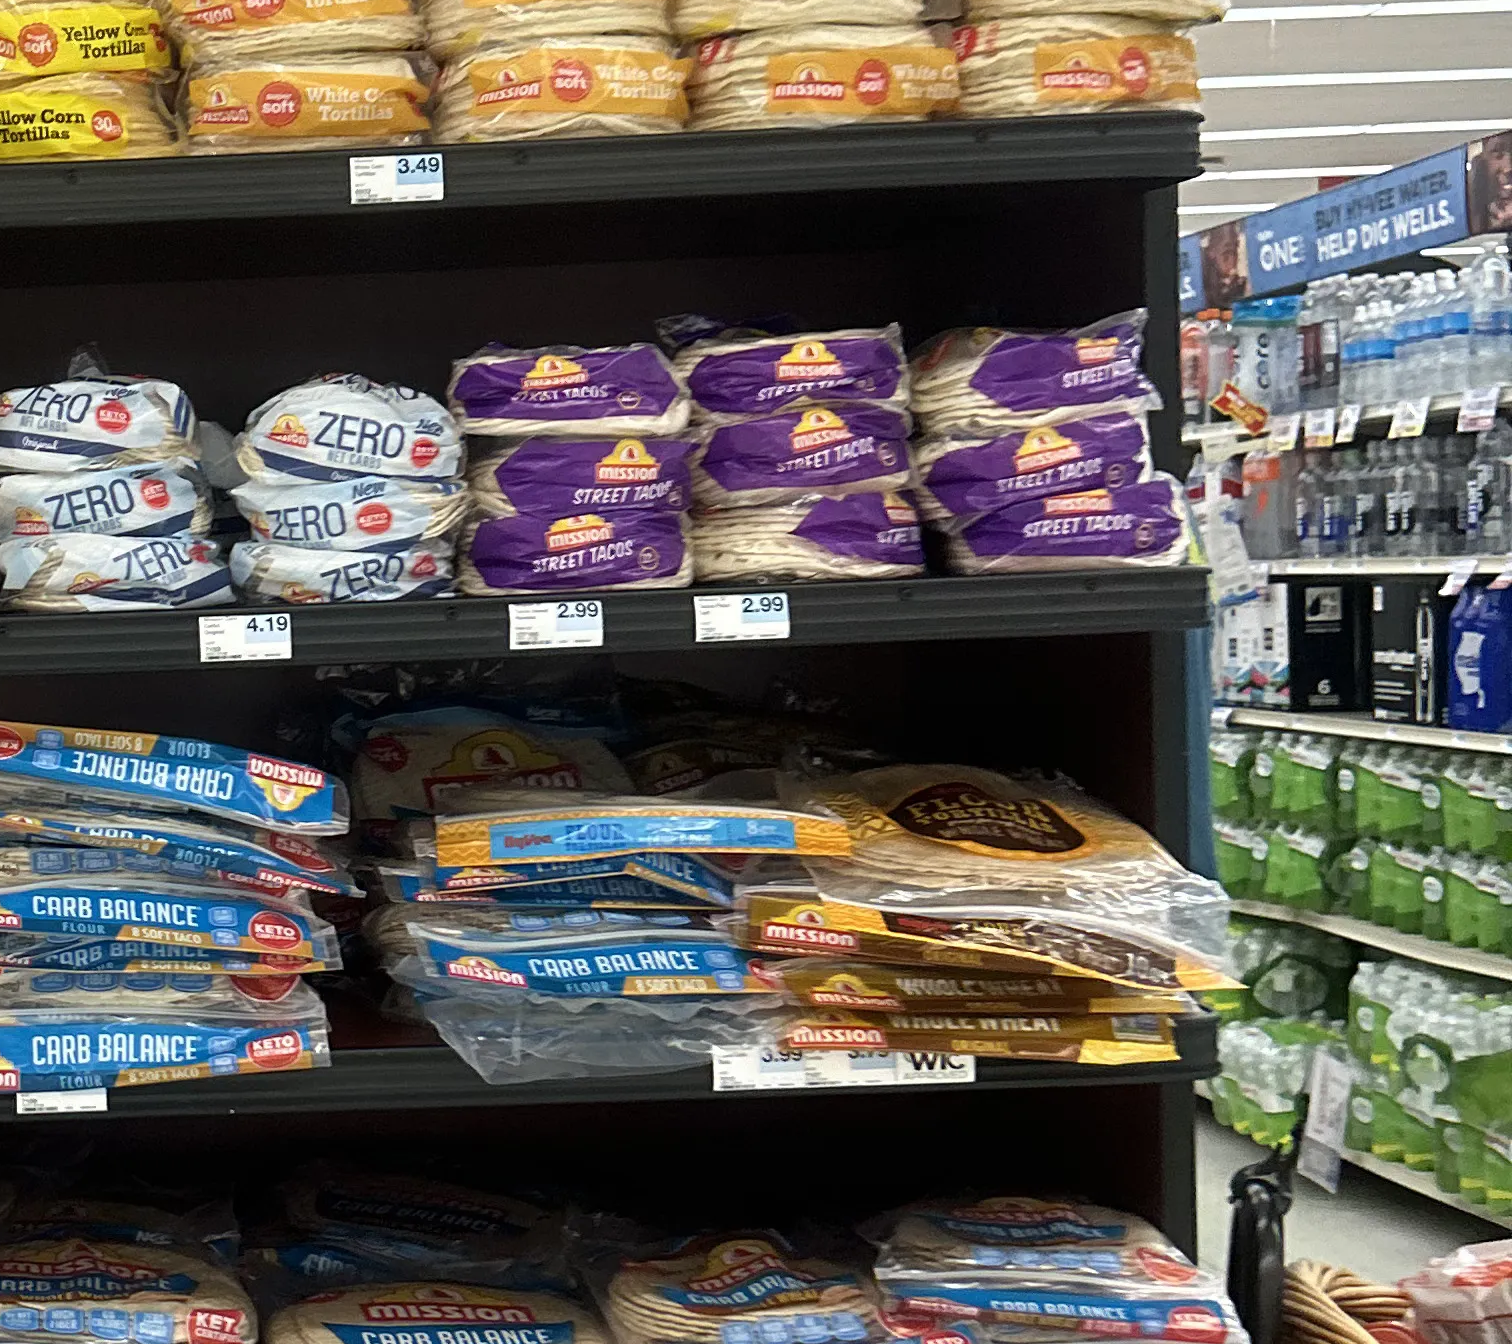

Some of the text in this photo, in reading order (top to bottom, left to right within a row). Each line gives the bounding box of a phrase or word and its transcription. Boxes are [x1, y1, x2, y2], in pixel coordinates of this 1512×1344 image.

[62, 24, 121, 42] Yellow
[306, 88, 360, 104] White
[41, 110, 86, 125] Corn
[397, 157, 440, 174] 3.49
[1317, 199, 1456, 261] HELP DIG WELLS.
[352, 481, 386, 502] New
[45, 478, 135, 531] ZERO
[1023, 516, 1132, 538] STREET TACOS
[532, 540, 633, 573] STREET TACOS
[557, 603, 599, 619] 2.99
[741, 596, 784, 614] 2.99
[247, 617, 288, 633] 4.19
[32, 896, 202, 926] CARB BALANCE
[62, 923, 105, 935] FLOUR
[131, 927, 202, 944] 8 SOFT TACO
[254, 923, 297, 937] KETO
[31, 1035, 202, 1065] CARB BALANCE
[906, 1053, 967, 1076] WIC
[59, 1074, 104, 1089] FLOUR
